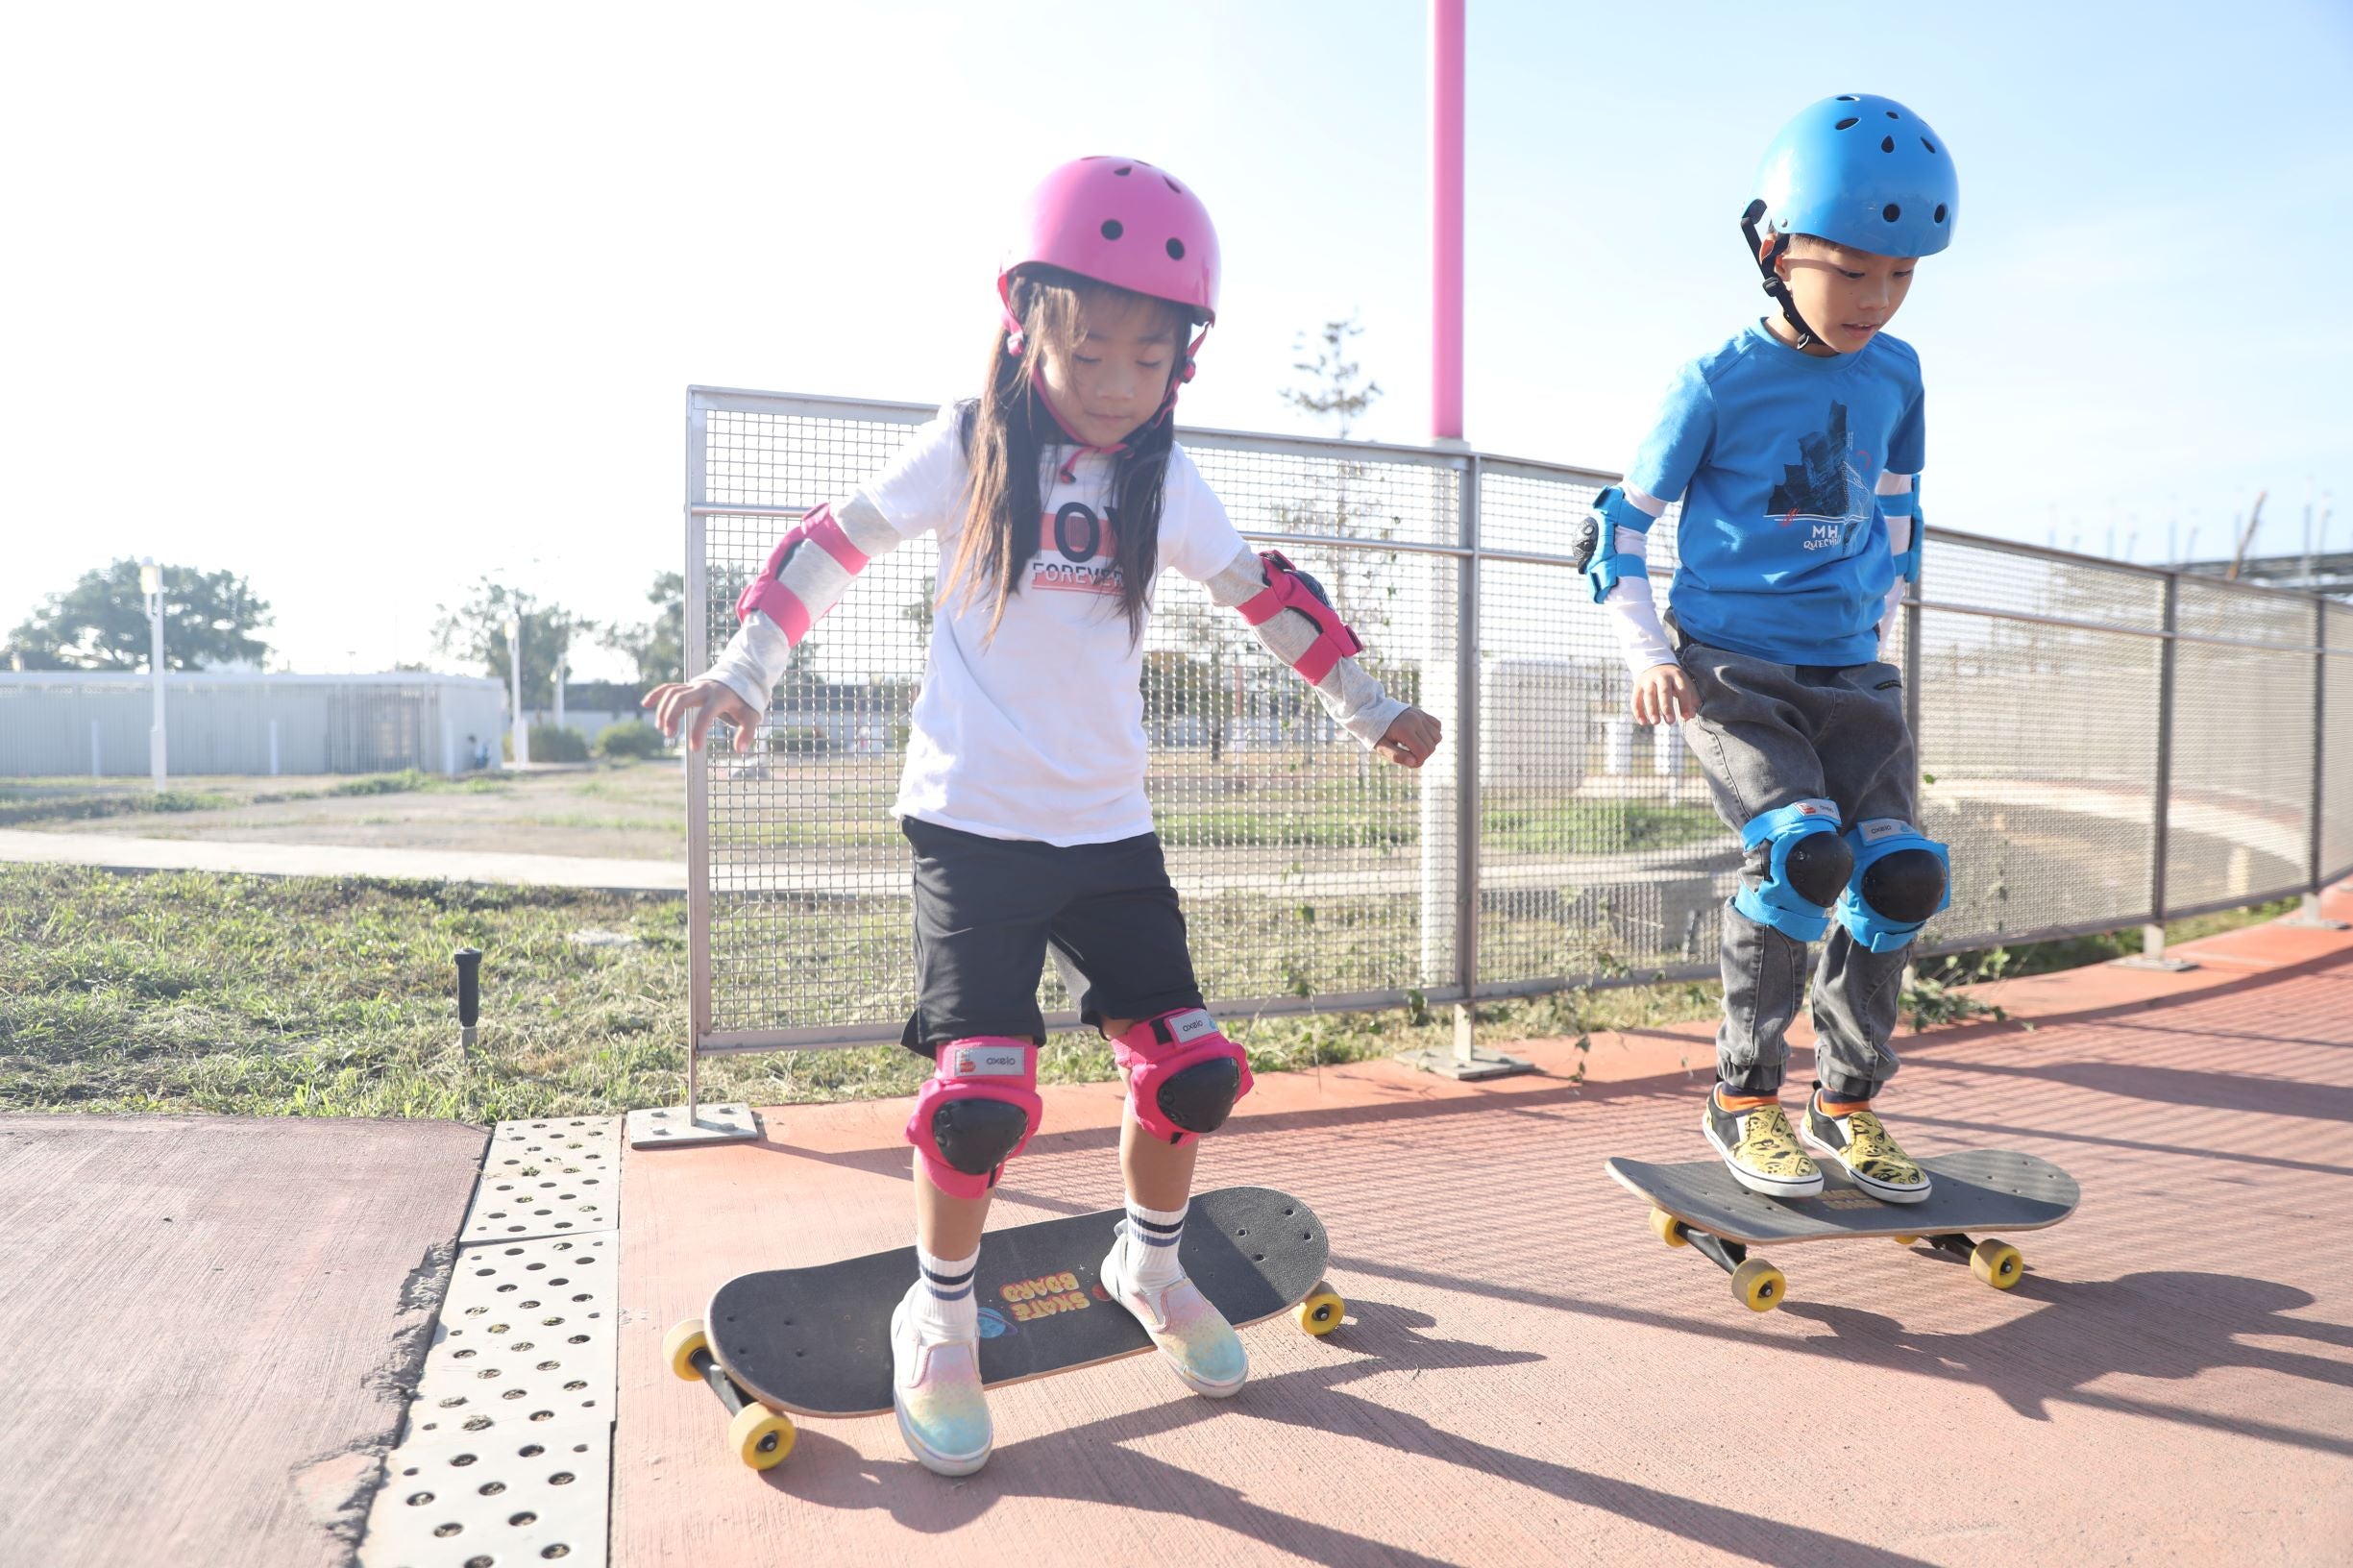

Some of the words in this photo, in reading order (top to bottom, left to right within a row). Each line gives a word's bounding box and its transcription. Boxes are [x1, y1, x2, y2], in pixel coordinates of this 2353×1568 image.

[1803, 535, 1842, 551] QUECHU
[1812, 525, 1838, 538] MH
[1032, 562, 1124, 588] FOREVER
[999, 1270, 1080, 1303] BOARD
[1010, 1291, 1091, 1322] SKATE
